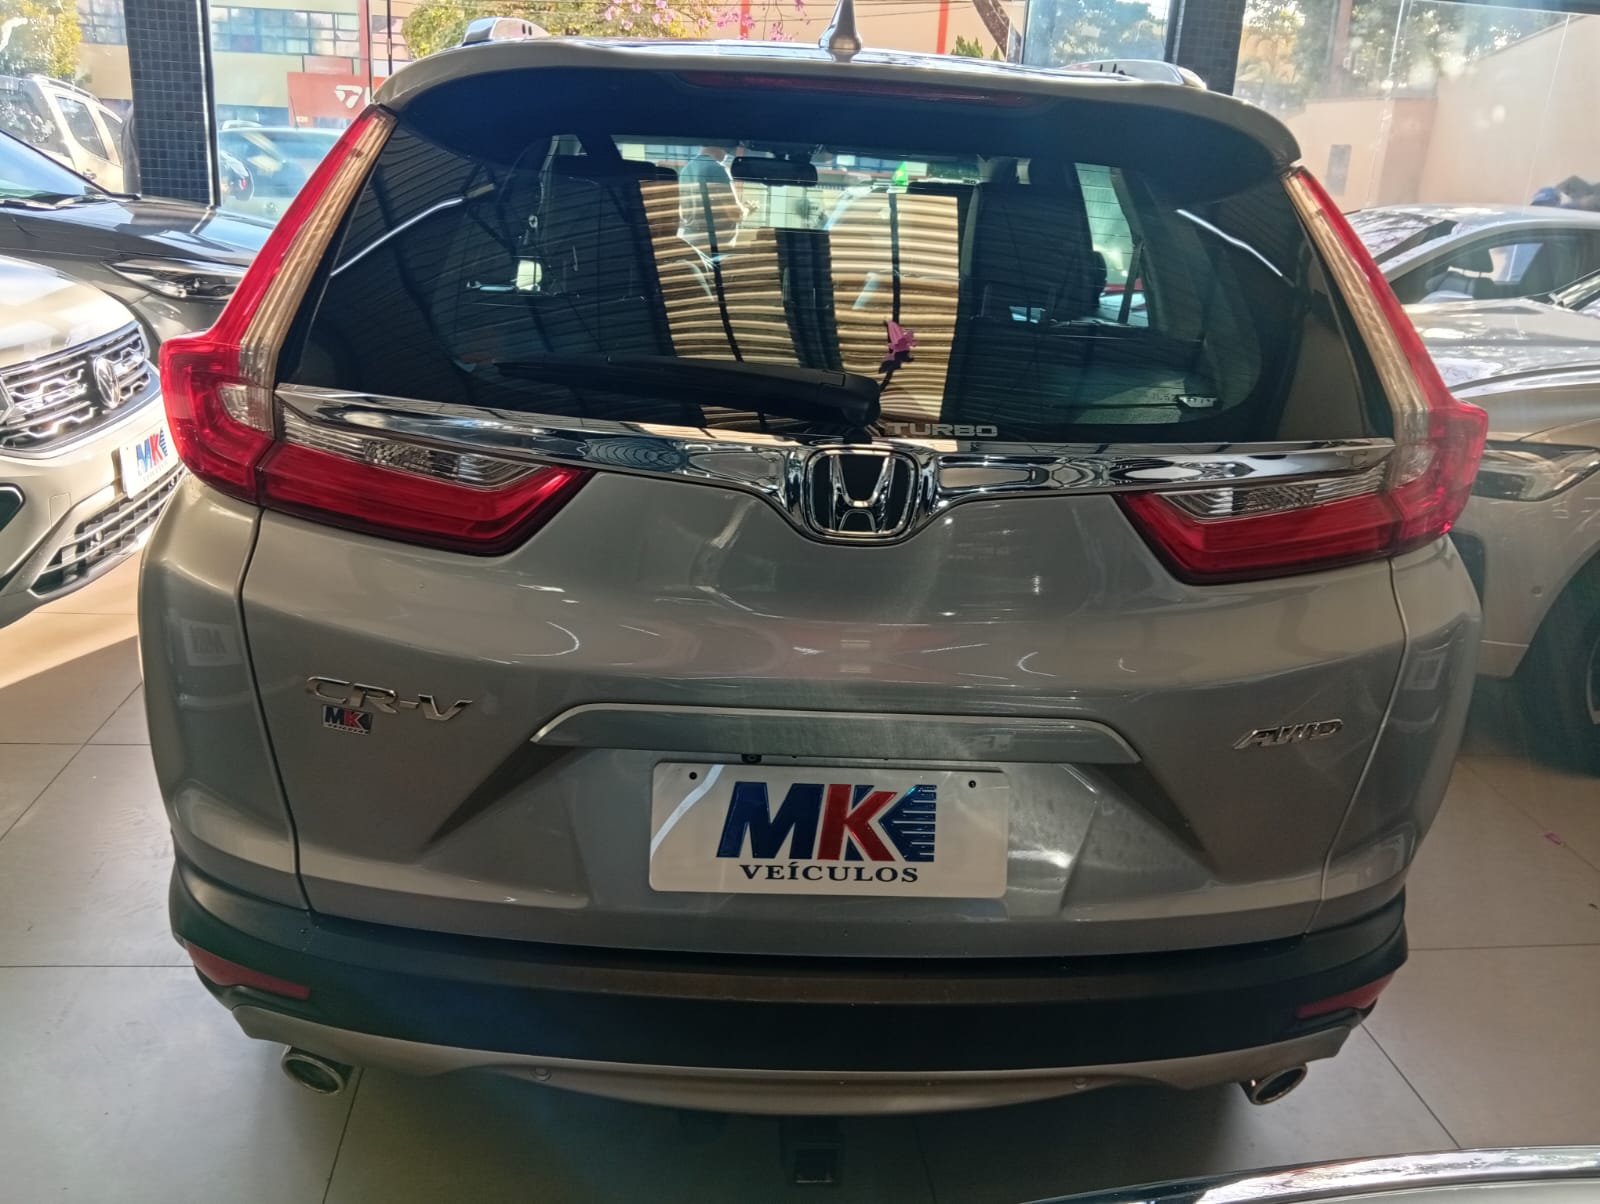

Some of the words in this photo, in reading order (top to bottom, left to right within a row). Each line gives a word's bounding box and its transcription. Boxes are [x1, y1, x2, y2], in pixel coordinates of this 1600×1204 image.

[885, 422, 999, 437] TURBO
[305, 676, 473, 721] CR-V
[325, 706, 362, 729] MK
[1232, 719, 1343, 749] AWD
[716, 781, 899, 861] MK
[740, 862, 919, 883] VEÍCULOS
